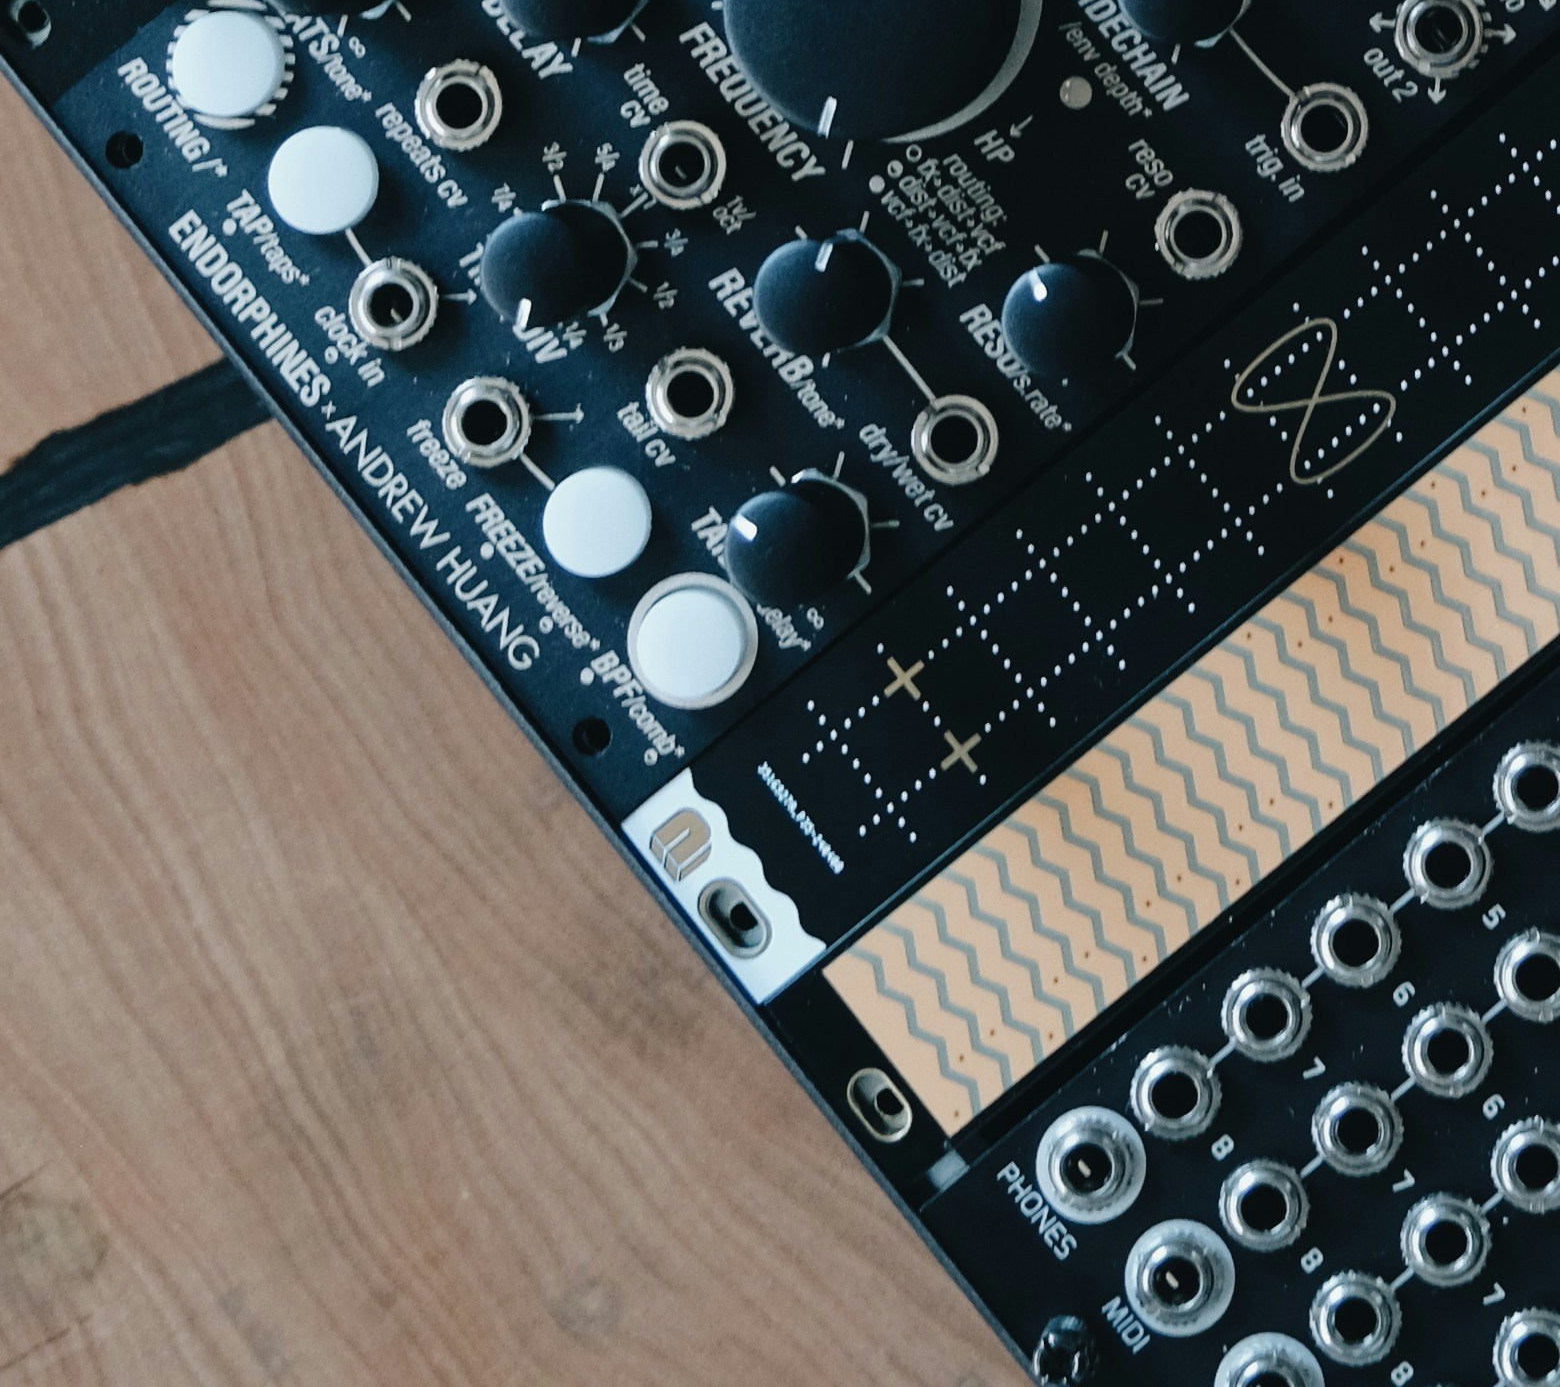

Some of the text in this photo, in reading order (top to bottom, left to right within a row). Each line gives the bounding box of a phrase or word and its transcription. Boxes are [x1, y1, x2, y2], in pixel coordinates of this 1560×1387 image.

[676, 20, 827, 183] FREQUENCY
[372, 101, 469, 210] repeats cv
[165, 207, 541, 672] ENDORPHINES ANDREW HUANG
[404, 418, 469, 491] freeze
[994, 1159, 1079, 1262] PHONES
[1099, 1294, 1152, 1356] MIDI
